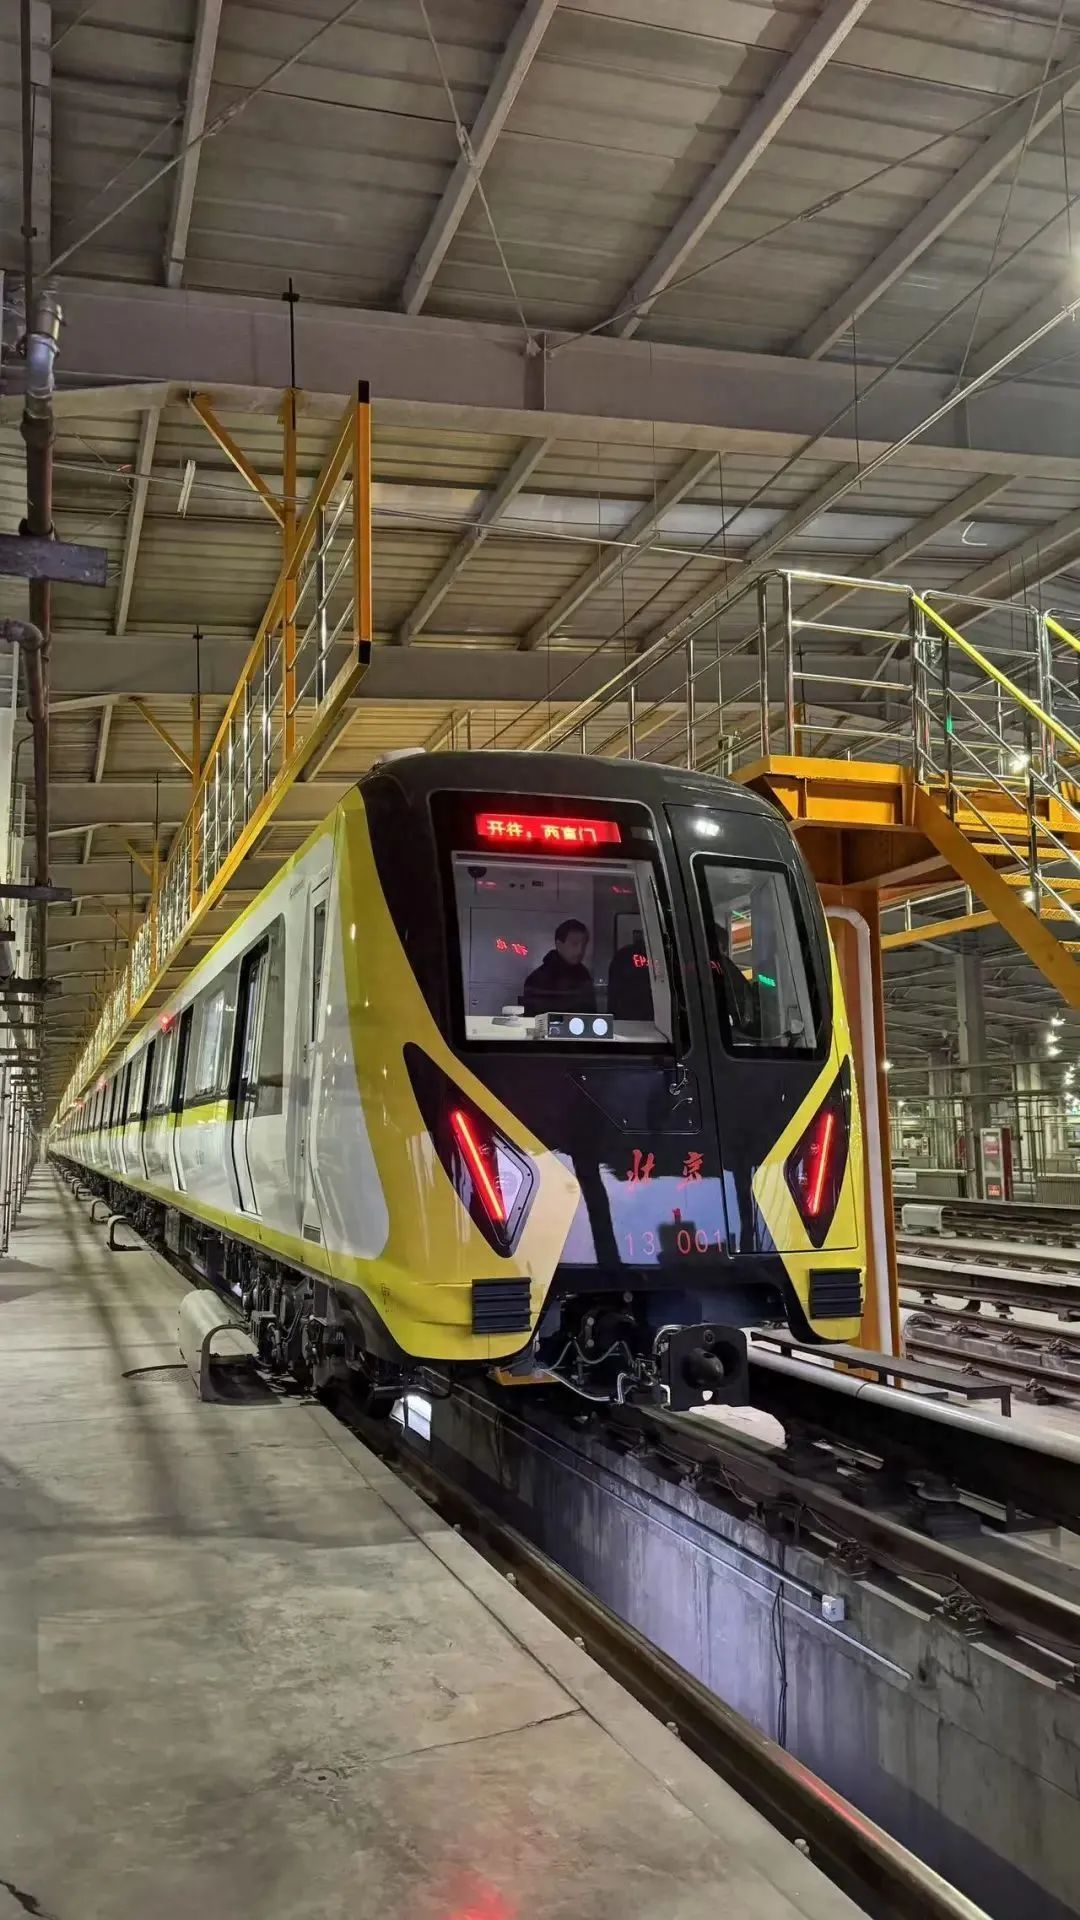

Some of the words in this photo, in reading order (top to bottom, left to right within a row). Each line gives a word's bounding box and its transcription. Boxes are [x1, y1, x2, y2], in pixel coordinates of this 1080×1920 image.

[625, 1149, 704, 1194] 北京
[625, 1231, 655, 1256] 13
[677, 1229, 722, 1254] 001
